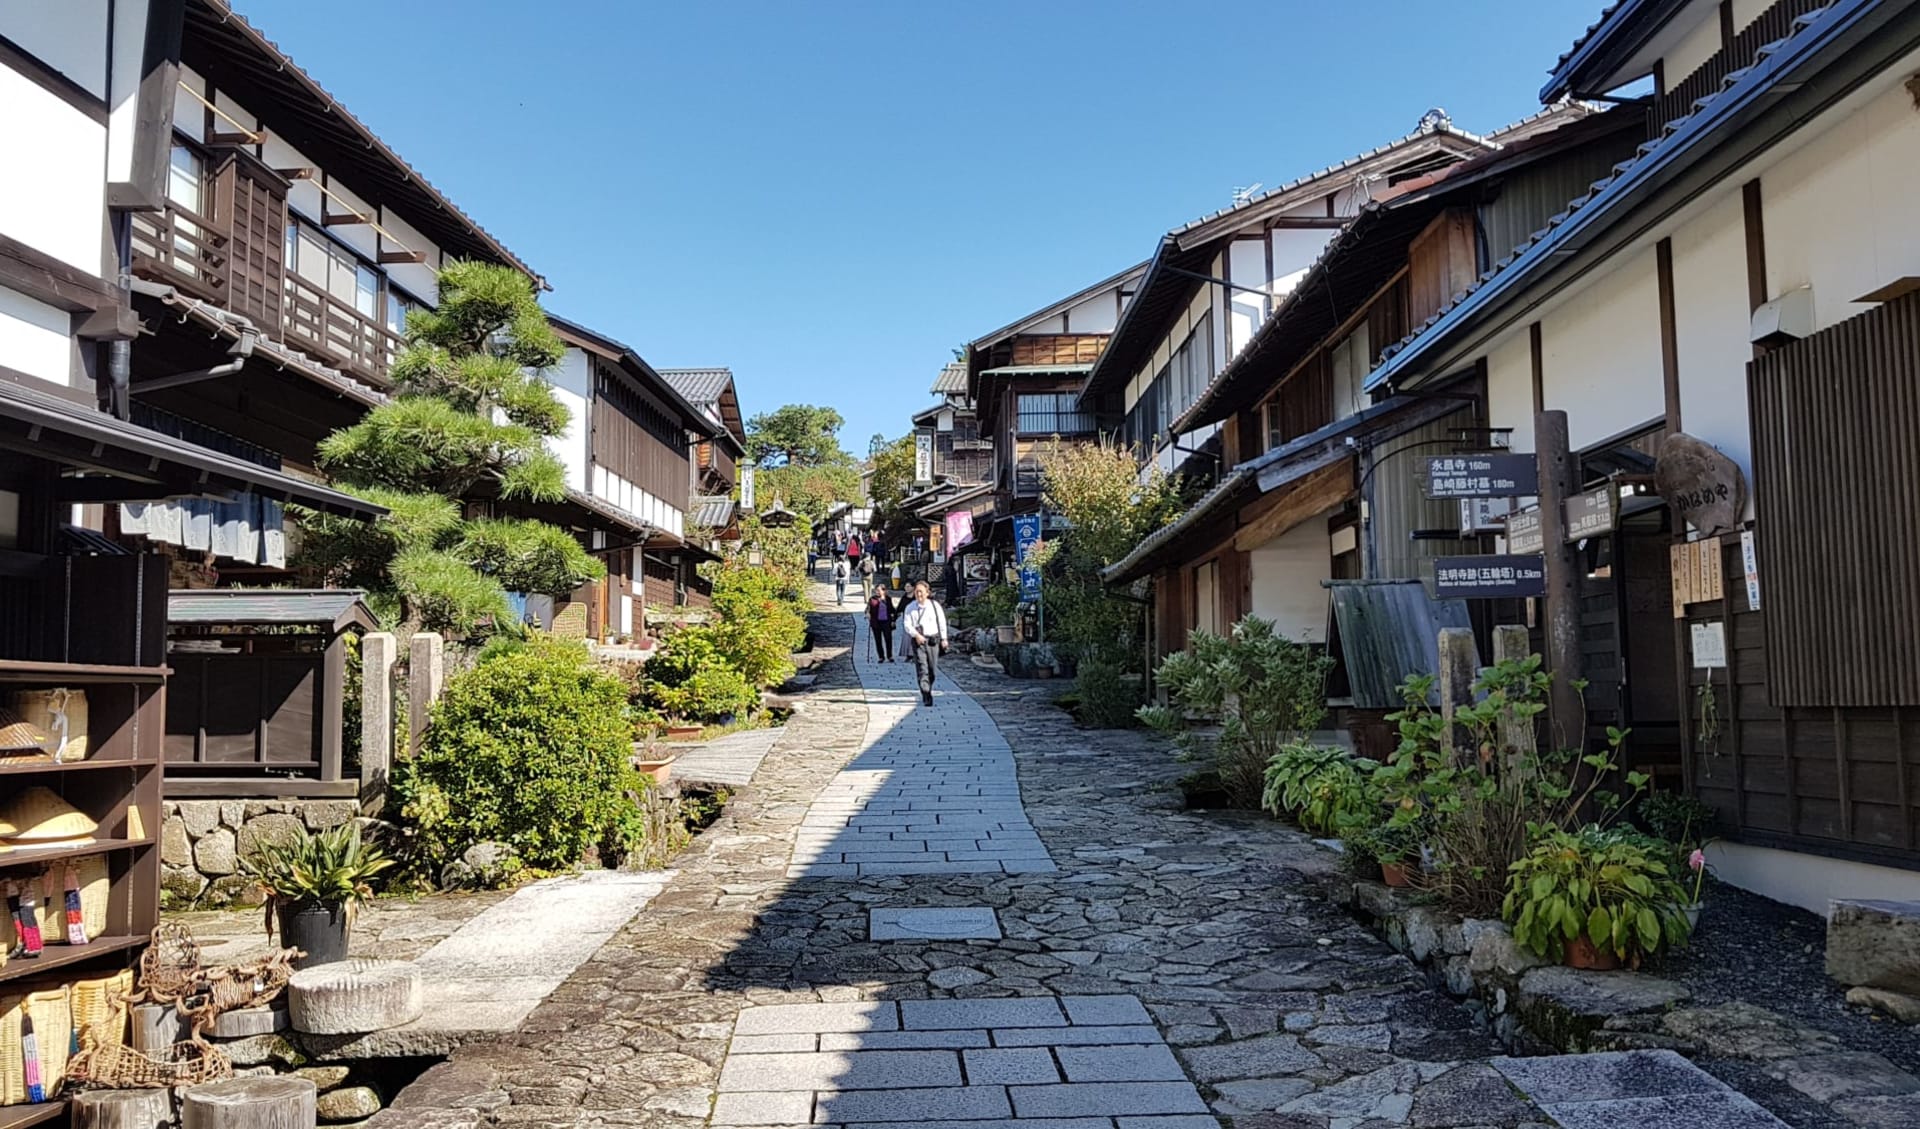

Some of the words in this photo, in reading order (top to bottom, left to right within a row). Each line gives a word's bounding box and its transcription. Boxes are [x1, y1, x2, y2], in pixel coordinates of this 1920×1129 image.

[1432, 459, 1466, 471] 永昌寺
[1432, 477, 1490, 490] 島崎藤村墓
[1516, 570, 1541, 578] 0.5km
